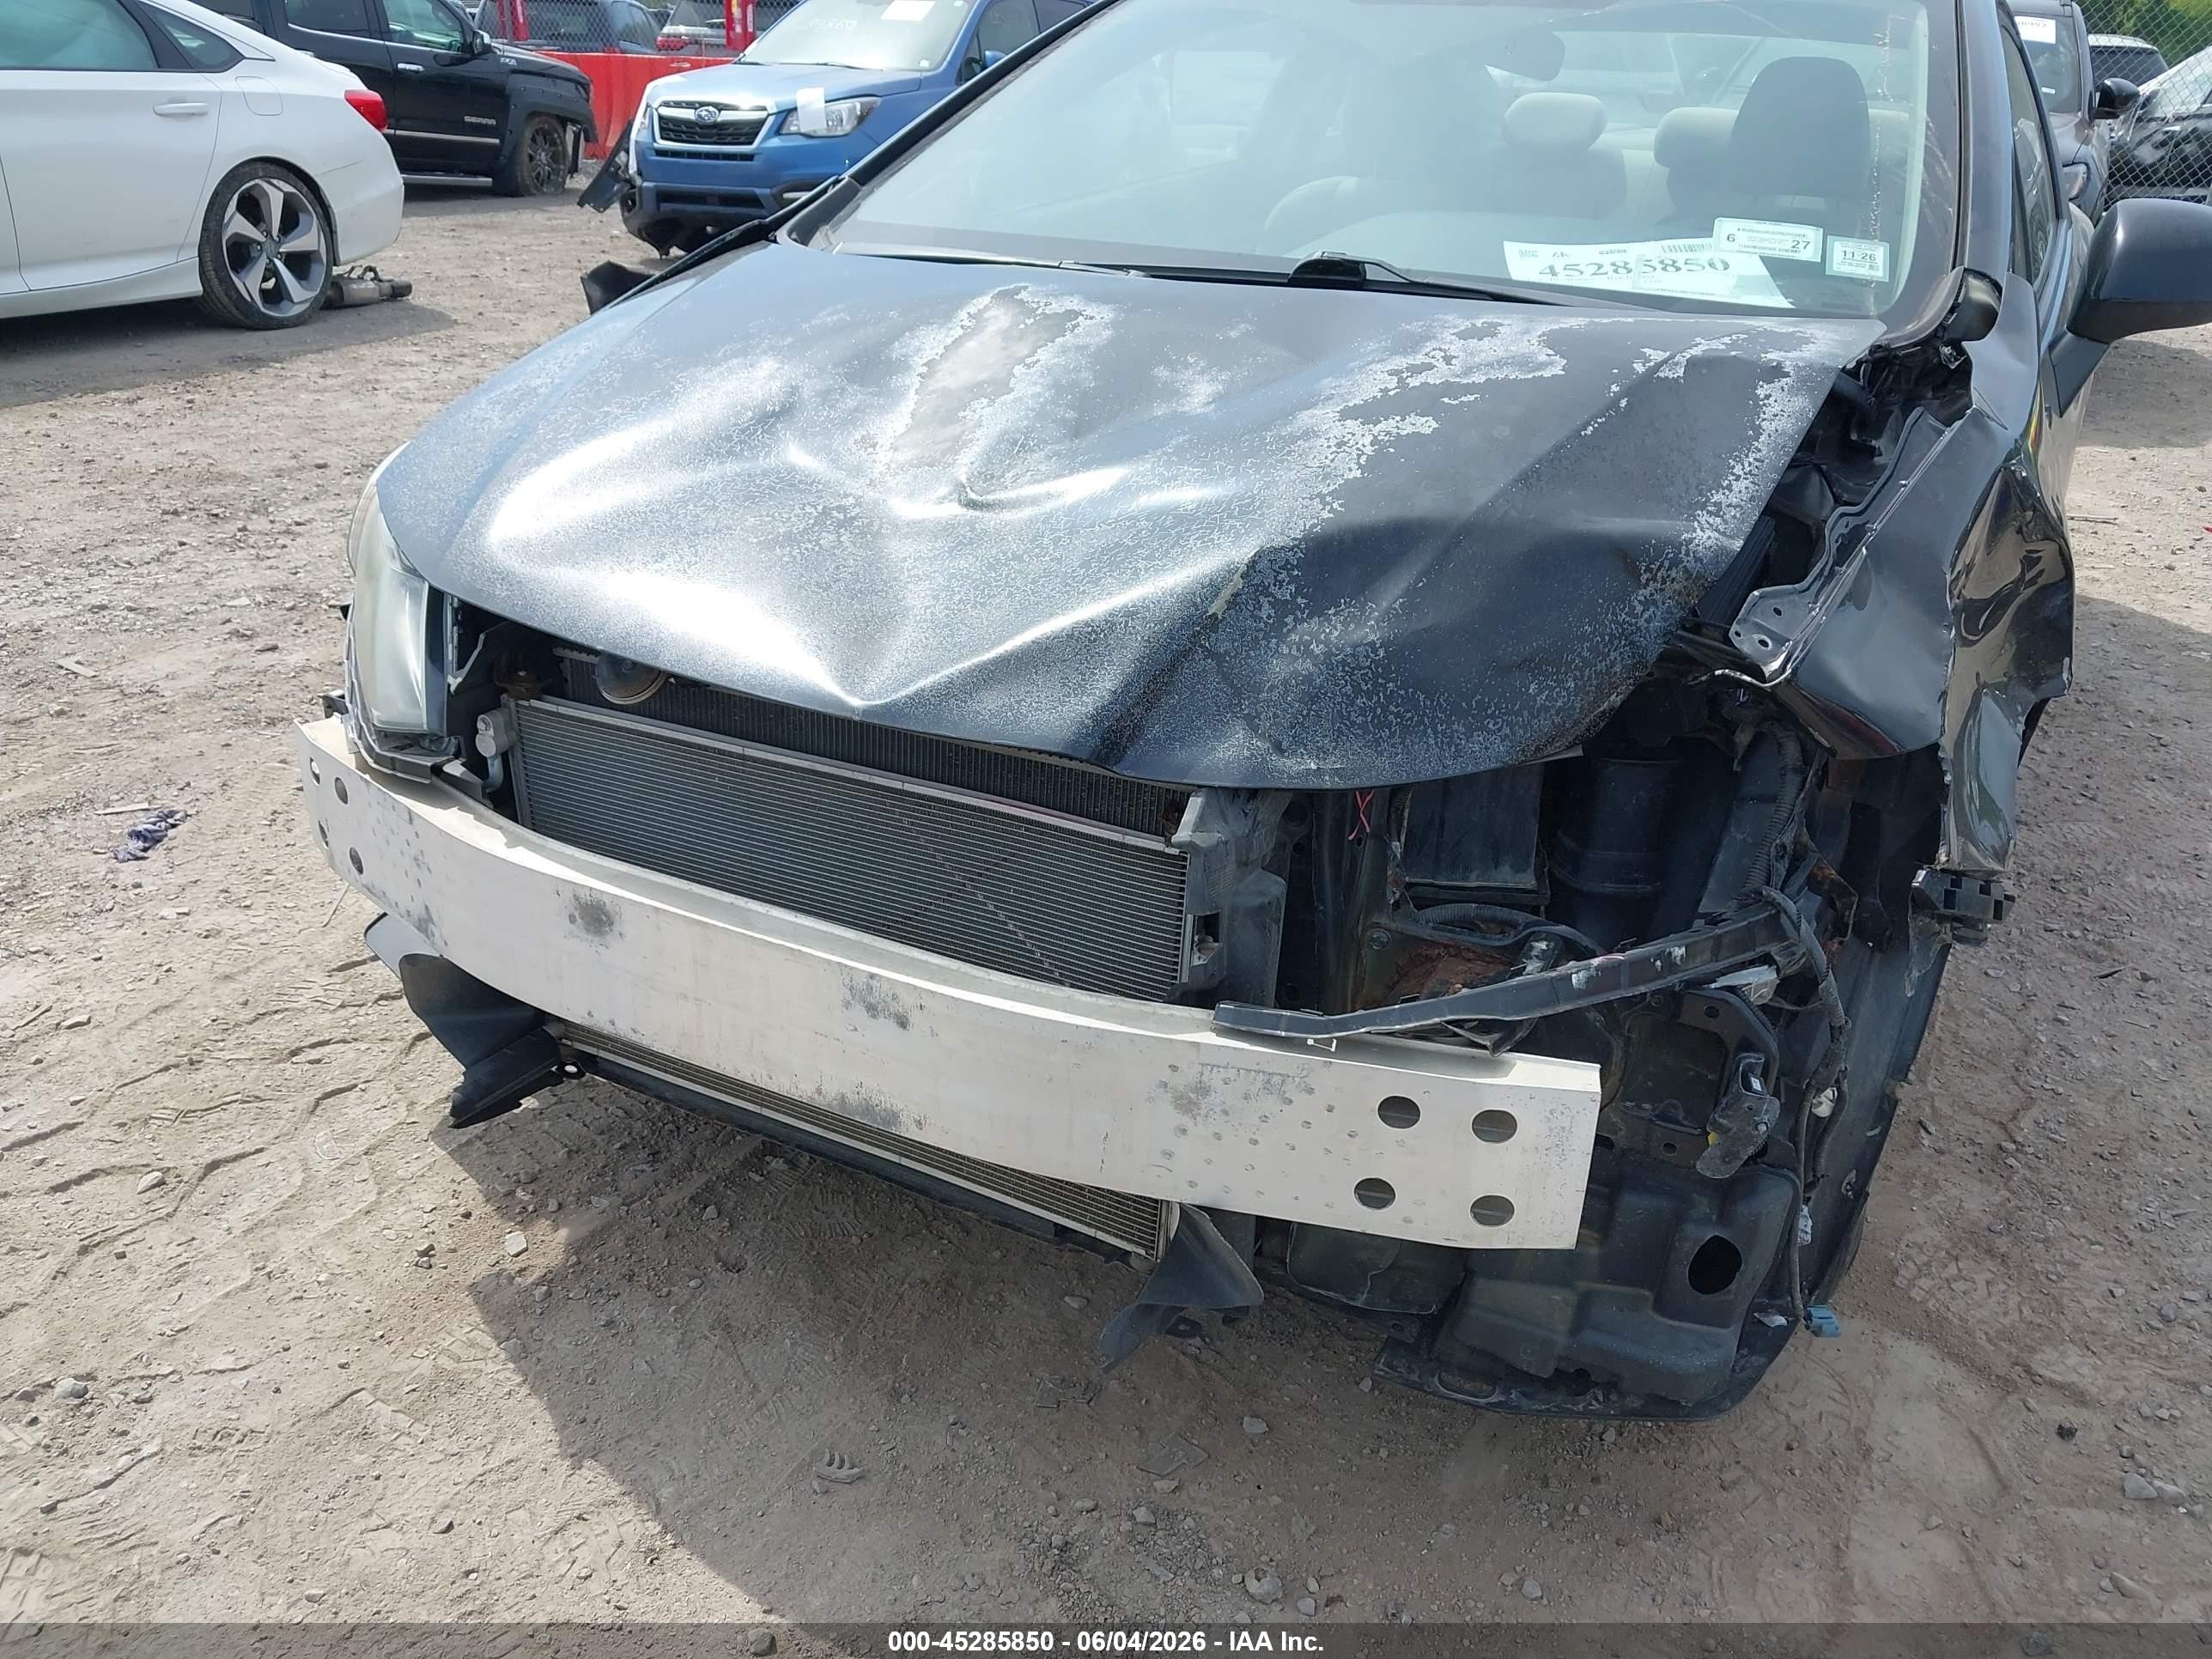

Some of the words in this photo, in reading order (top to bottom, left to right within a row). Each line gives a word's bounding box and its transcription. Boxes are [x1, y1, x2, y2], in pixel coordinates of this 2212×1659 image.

[1726, 234, 1736, 242] 6
[1790, 240, 1811, 250] 27
[1538, 257, 1730, 277] 45285850
